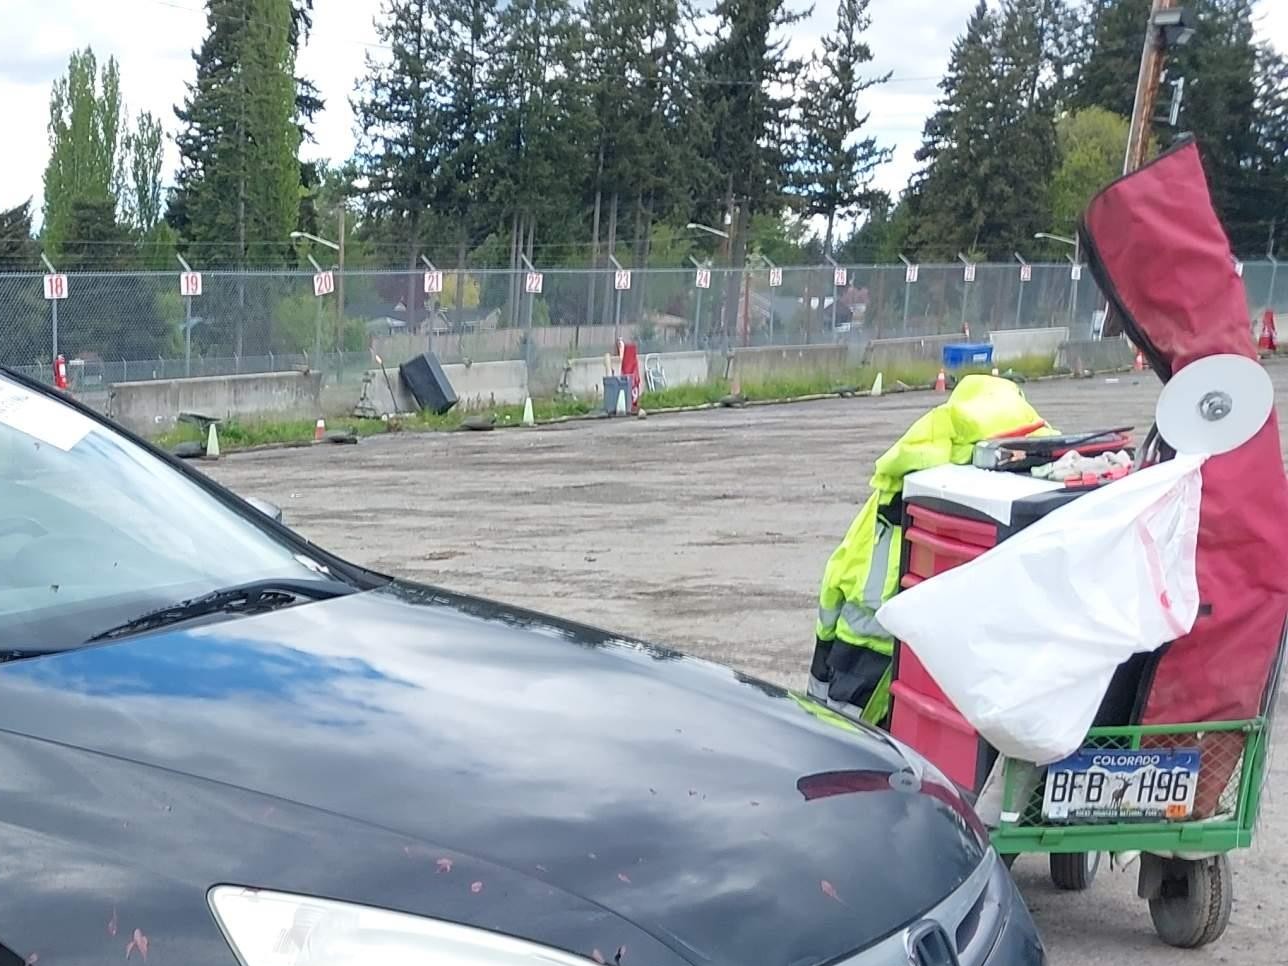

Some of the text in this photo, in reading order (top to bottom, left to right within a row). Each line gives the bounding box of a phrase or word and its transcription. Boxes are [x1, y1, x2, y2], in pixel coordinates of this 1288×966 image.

[48, 276, 64, 297] 18
[184, 274, 200, 293] 19
[316, 274, 332, 294] 20
[428, 273, 441, 290] 21
[528, 274, 542, 290] 22
[617, 272, 629, 289] 23
[1092, 755, 1160, 766] COLORADO
[1051, 771, 1190, 803] BFB H96
